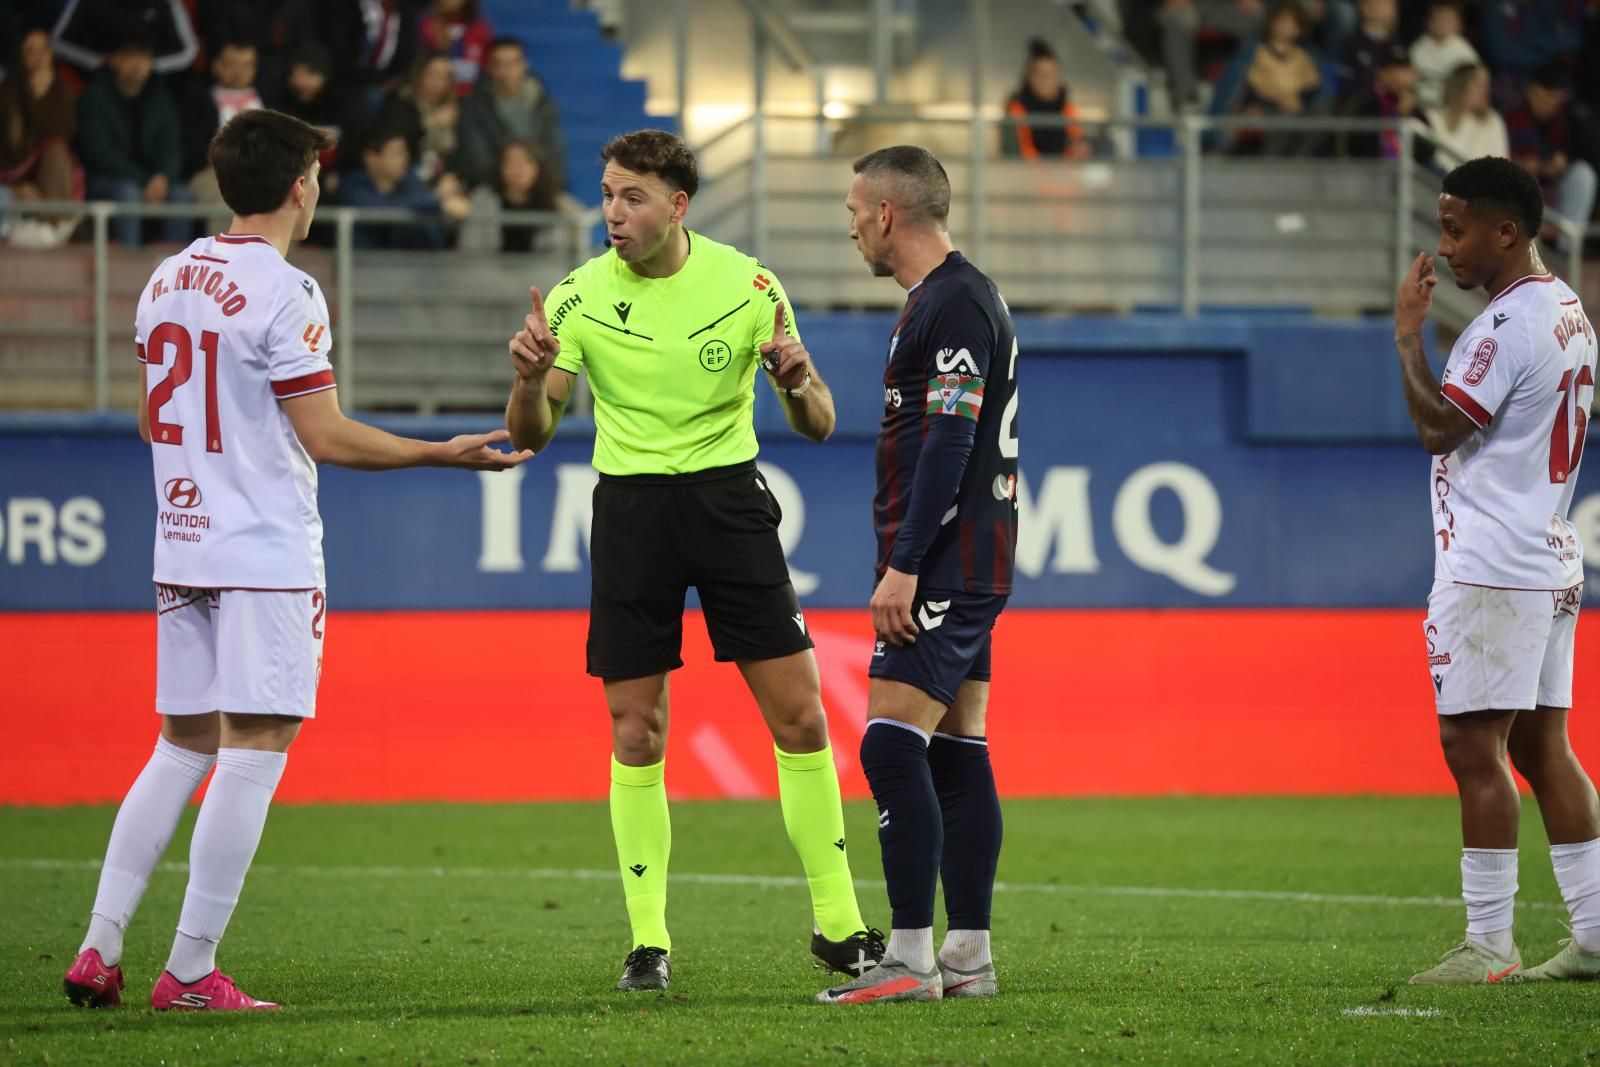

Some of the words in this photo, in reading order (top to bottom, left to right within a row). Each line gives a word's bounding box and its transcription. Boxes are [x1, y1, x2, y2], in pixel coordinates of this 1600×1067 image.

[549, 293, 583, 337] WÜRTH
[706, 347, 725, 356] RF
[706, 356, 725, 365] EF
[147, 322, 222, 454] 21
[160, 511, 210, 529] HYUNDAI
[0, 496, 107, 567] RS
[163, 528, 202, 543] Lemauto
